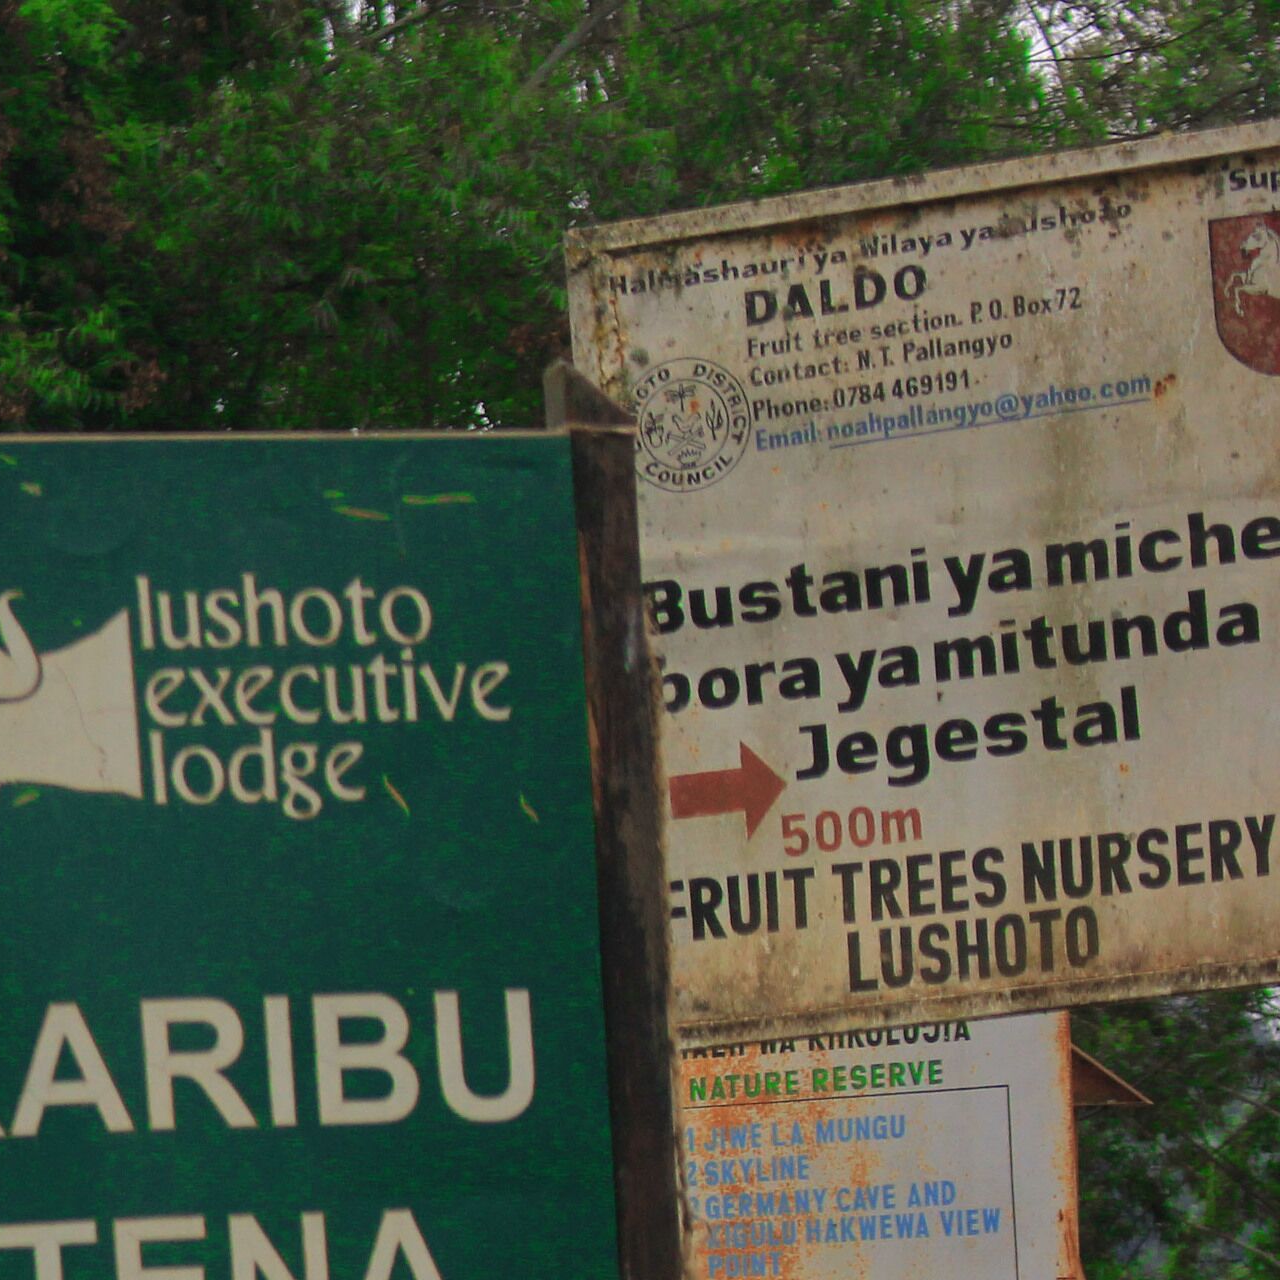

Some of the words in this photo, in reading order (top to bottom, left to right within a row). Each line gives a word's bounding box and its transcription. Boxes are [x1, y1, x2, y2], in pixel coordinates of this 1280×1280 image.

[813, 248, 848, 274] ya
[859, 233, 953, 258] Wilaya
[959, 225, 995, 250] ya
[744, 265, 927, 326] DALDO
[747, 332, 804, 358] Fruit
[813, 328, 862, 349] tree
[750, 355, 848, 388] Contact:
[902, 333, 1013, 364] Pallangyo
[694, 363, 747, 446] DISTRICT
[891, 367, 971, 400] 469191
[645, 455, 734, 486] COUNCIL
[643, 547, 932, 635] Bustani
[943, 546, 1033, 618] ya
[1045, 512, 1280, 587] miche
[136, 573, 432, 650] lushoto
[835, 645, 921, 713] ya
[934, 589, 1262, 682] mitunda
[145, 648, 512, 728] executive
[795, 686, 1141, 788] Jegestal
[150, 727, 367, 820] lodge
[781, 806, 924, 858] 500m
[831, 846, 1009, 925] TREES
[1021, 813, 1277, 905] NURSERY
[846, 905, 1101, 994] LUSHOTO
[690, 1070, 800, 1102] NATURE
[811, 1059, 944, 1093] RESERVE
[704, 1123, 762, 1151] JIWE
[772, 1120, 804, 1146] LA
[816, 1114, 905, 1143] MUNGU
[704, 1155, 810, 1186] SKYLINE
[705, 1188, 828, 1219] GERMANY
[836, 1184, 896, 1212] CAVE
[908, 1180, 957, 1208] AND
[806, 1211, 929, 1244] HAKWEWA
[940, 1207, 1001, 1237] VIEW
[708, 1251, 783, 1278] POINT
